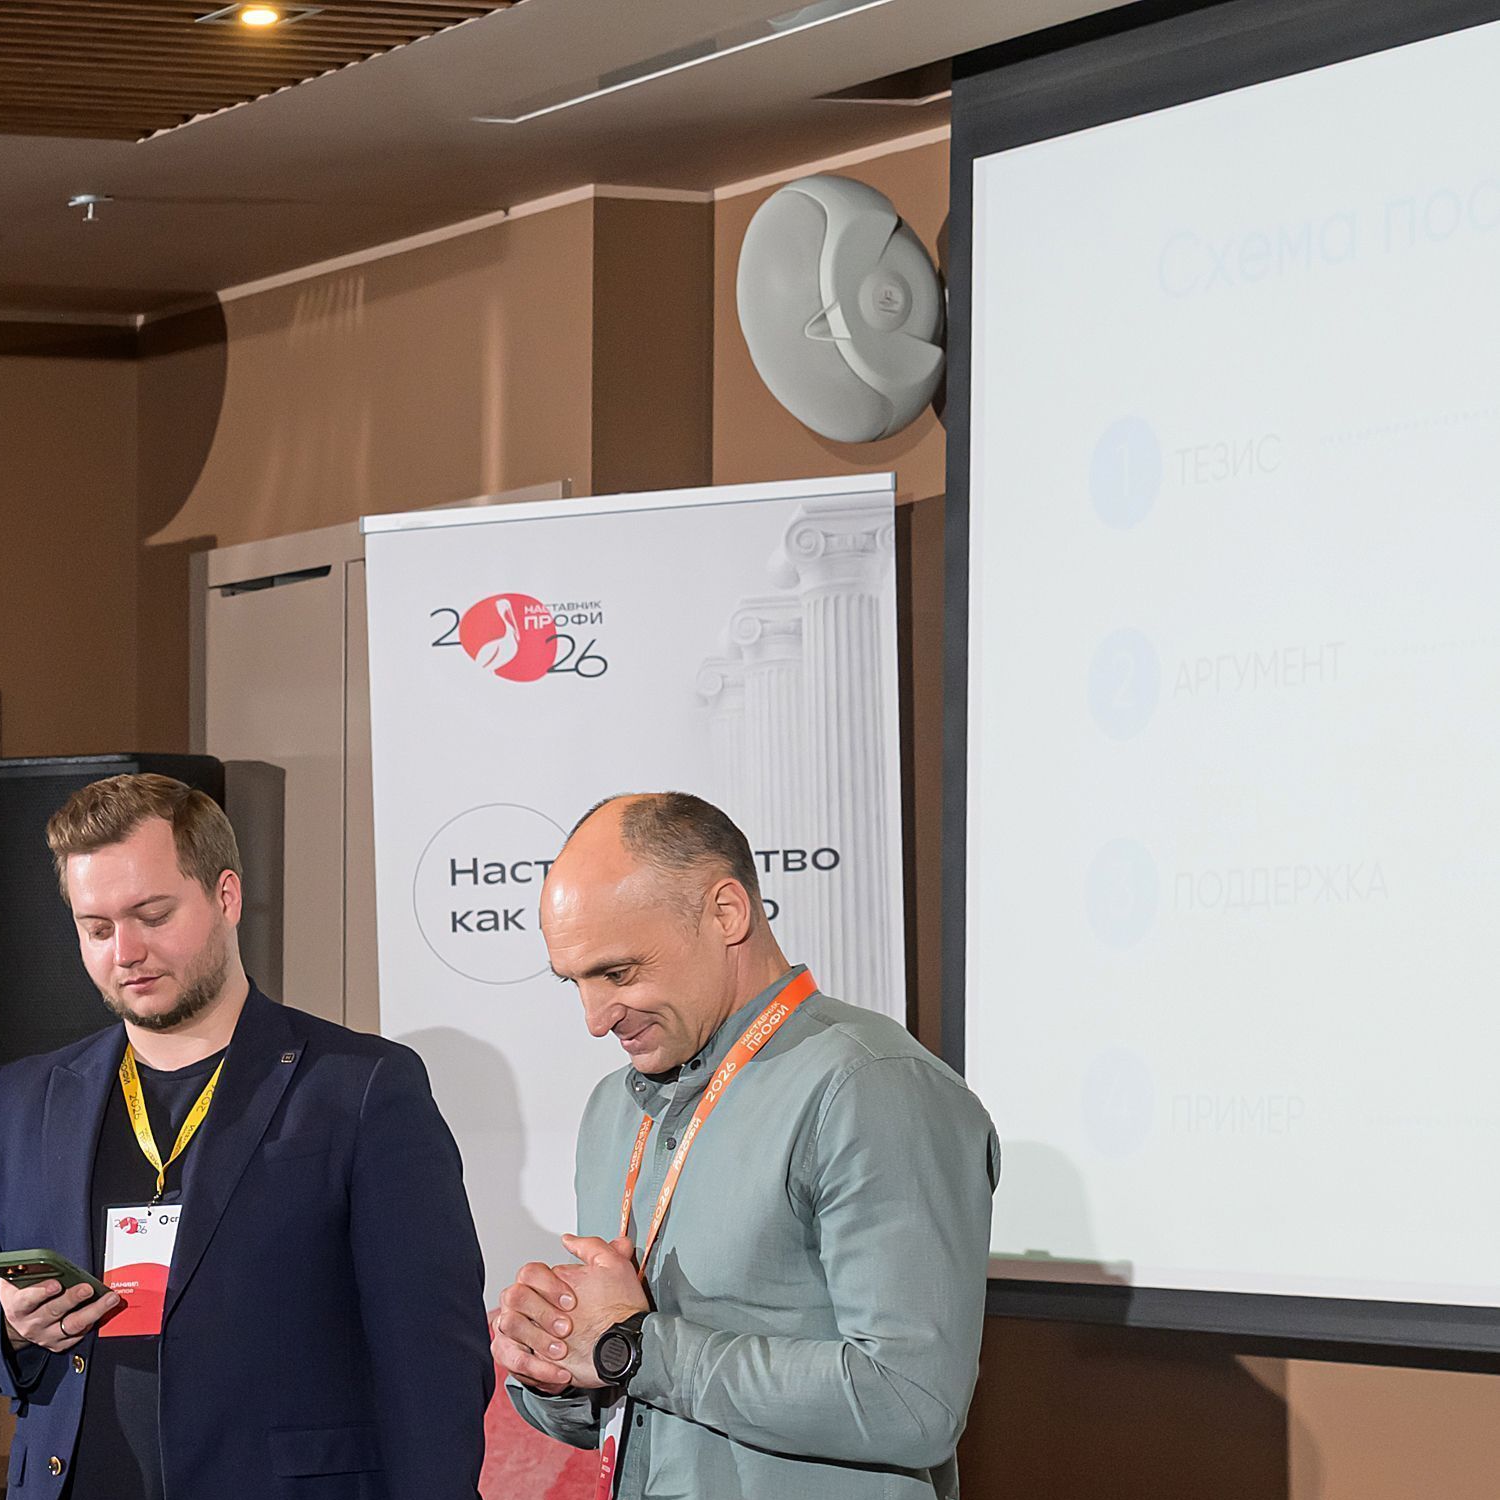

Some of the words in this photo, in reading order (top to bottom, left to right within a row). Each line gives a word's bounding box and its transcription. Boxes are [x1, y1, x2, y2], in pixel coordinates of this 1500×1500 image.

[1159, 207, 1357, 299] Схема
[1175, 434, 1282, 487] ТЕЗИС
[524, 600, 602, 614] НАСТАВНИК
[524, 611, 603, 630] ПРОФИ
[1173, 641, 1347, 698] АРГУМЕНТ
[1174, 861, 1390, 914] ПОДДЕРЖКА
[450, 908, 526, 933] как
[741, 1000, 781, 1046] НАСТАВНИК
[746, 1004, 790, 1052] ПРОФИ
[705, 1061, 737, 1103] 2026
[129, 1091, 142, 1121] 2026
[1171, 1094, 1306, 1136] ПРИМЕР
